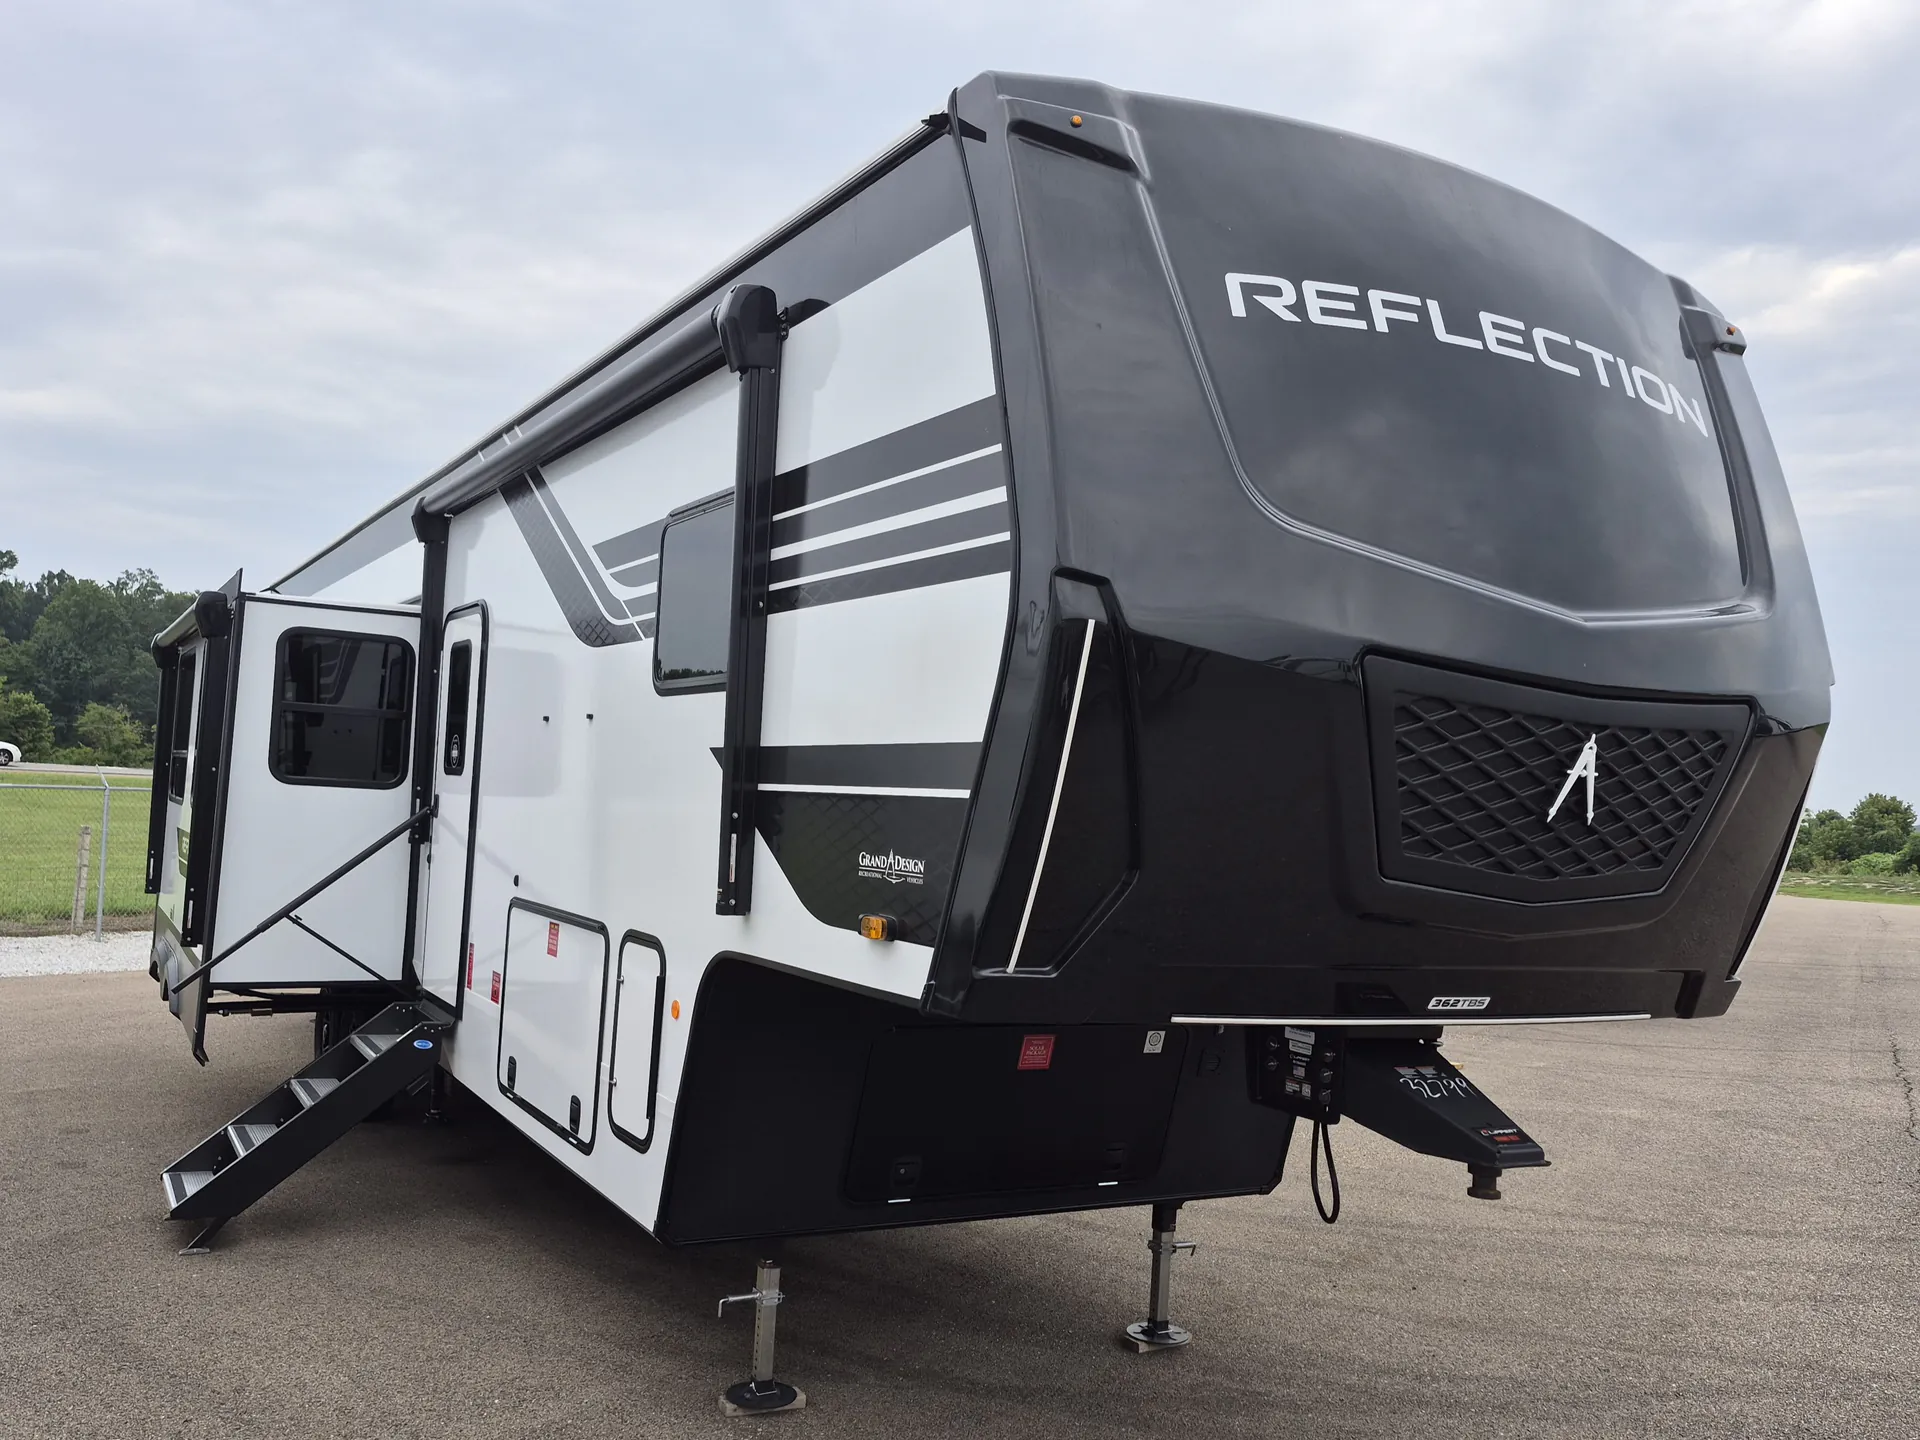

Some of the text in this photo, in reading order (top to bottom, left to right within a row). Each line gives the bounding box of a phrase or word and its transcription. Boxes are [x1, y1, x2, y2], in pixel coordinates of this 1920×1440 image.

[1224, 272, 1709, 438] REFLECTION
[859, 851, 925, 873] GRAND DESIGN
[1431, 999, 1487, 1008] 362TBS
